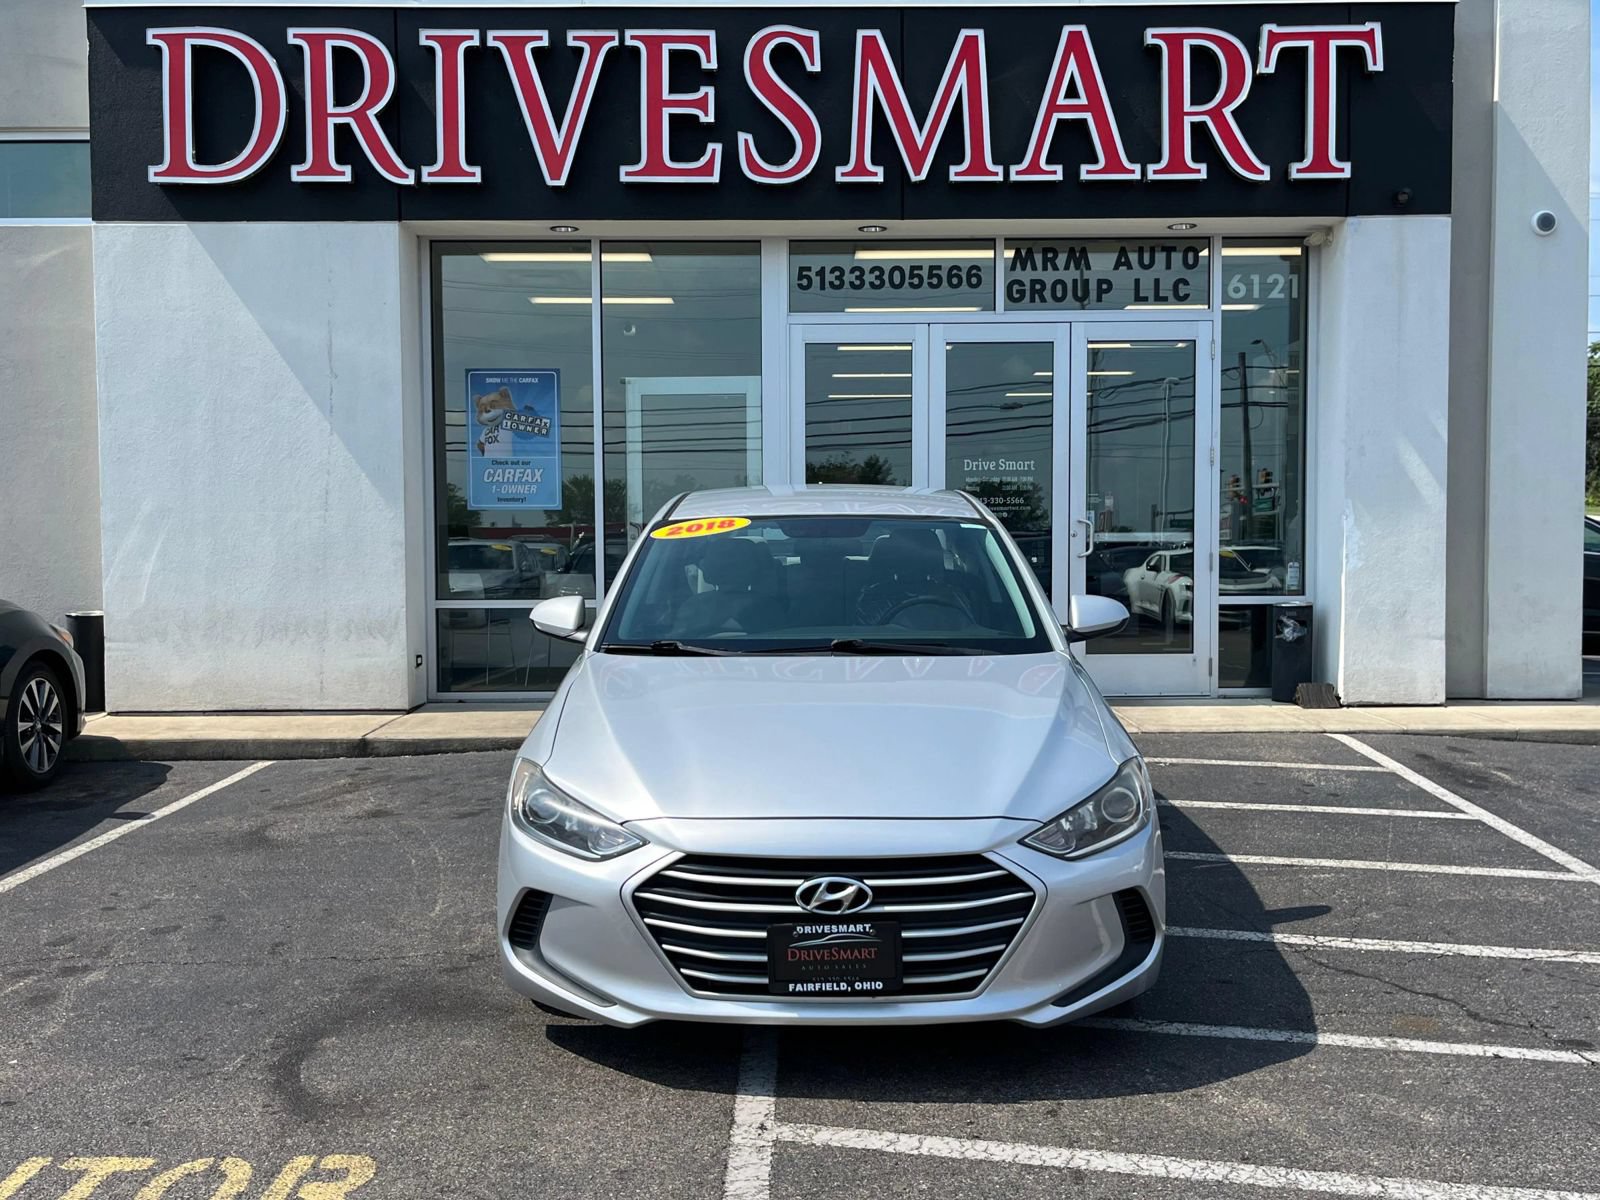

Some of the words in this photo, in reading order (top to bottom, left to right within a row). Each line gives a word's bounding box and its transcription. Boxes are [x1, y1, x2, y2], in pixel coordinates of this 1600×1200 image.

[146, 23, 1384, 187] DRIVESMART
[1009, 246, 1092, 271] MRM
[1113, 246, 1200, 270] AUTO
[797, 264, 983, 291] 5133305566
[1226, 273, 1299, 299] 6121
[1006, 278, 1114, 303] GROUP
[1133, 278, 1191, 302] LLC
[505, 412, 550, 428] CARFAX
[964, 458, 996, 470] Drive
[998, 458, 1036, 470] Smart
[483, 468, 543, 483] CARFAX
[491, 484, 537, 494] 1-OWNER
[666, 519, 736, 537] 2018
[796, 923, 872, 934] DRIVESMART
[788, 981, 852, 992] FAIRFIELD,
[854, 981, 883, 990] OHIO
